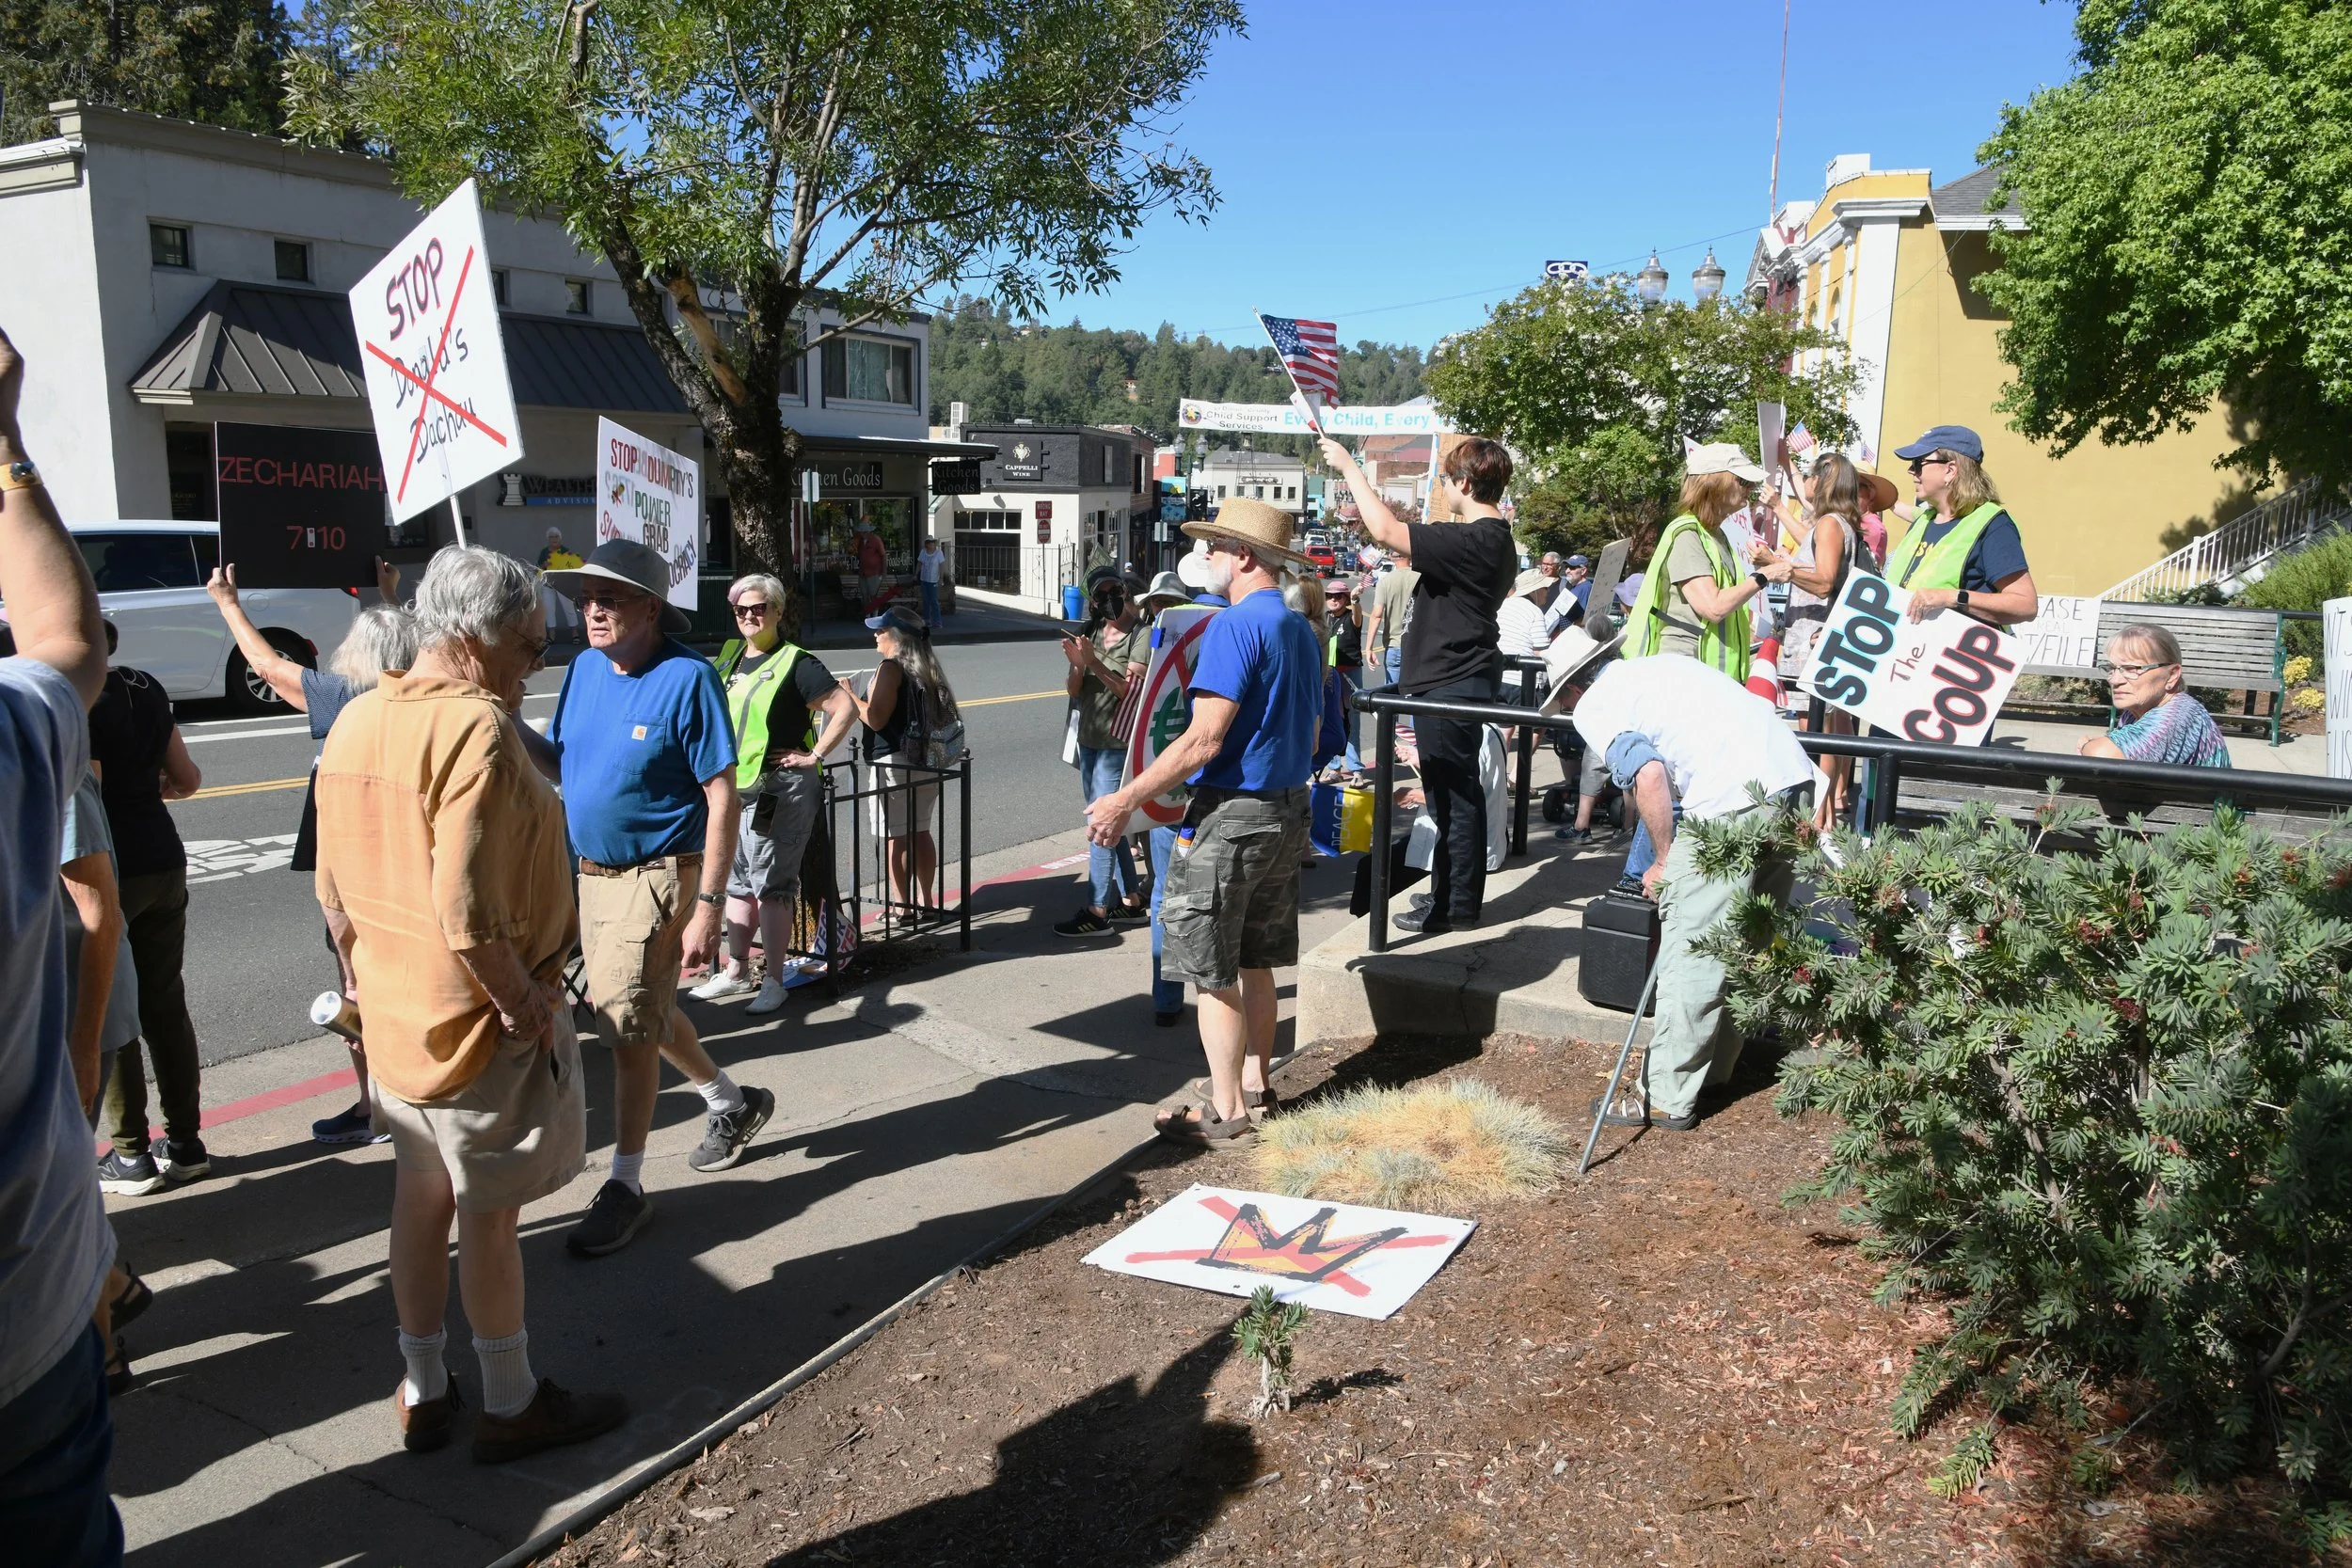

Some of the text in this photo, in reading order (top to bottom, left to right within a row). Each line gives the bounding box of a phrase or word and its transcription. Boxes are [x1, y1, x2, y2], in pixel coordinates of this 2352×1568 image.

[386, 237, 443, 341] STOP
[390, 326, 469, 409] Donald's
[1206, 411, 1278, 422] Child Support
[1219, 421, 1263, 431] Services
[1334, 411, 1378, 430] Child,
[217, 456, 384, 492] ZECHARIAH
[611, 438, 638, 474] STOP
[933, 463, 979, 478] Kitchen
[647, 454, 694, 499] DUMPTY'S
[843, 465, 881, 486] Goods
[938, 478, 976, 493] Goods
[634, 490, 671, 528] POWER
[286, 525, 346, 550] 7:10
[642, 523, 669, 554] GRAB
[1814, 575, 1900, 706] STOP
[1890, 643, 1927, 682] The
[1903, 624, 2016, 745] COUP
[1331, 796, 1354, 847] PEACE
